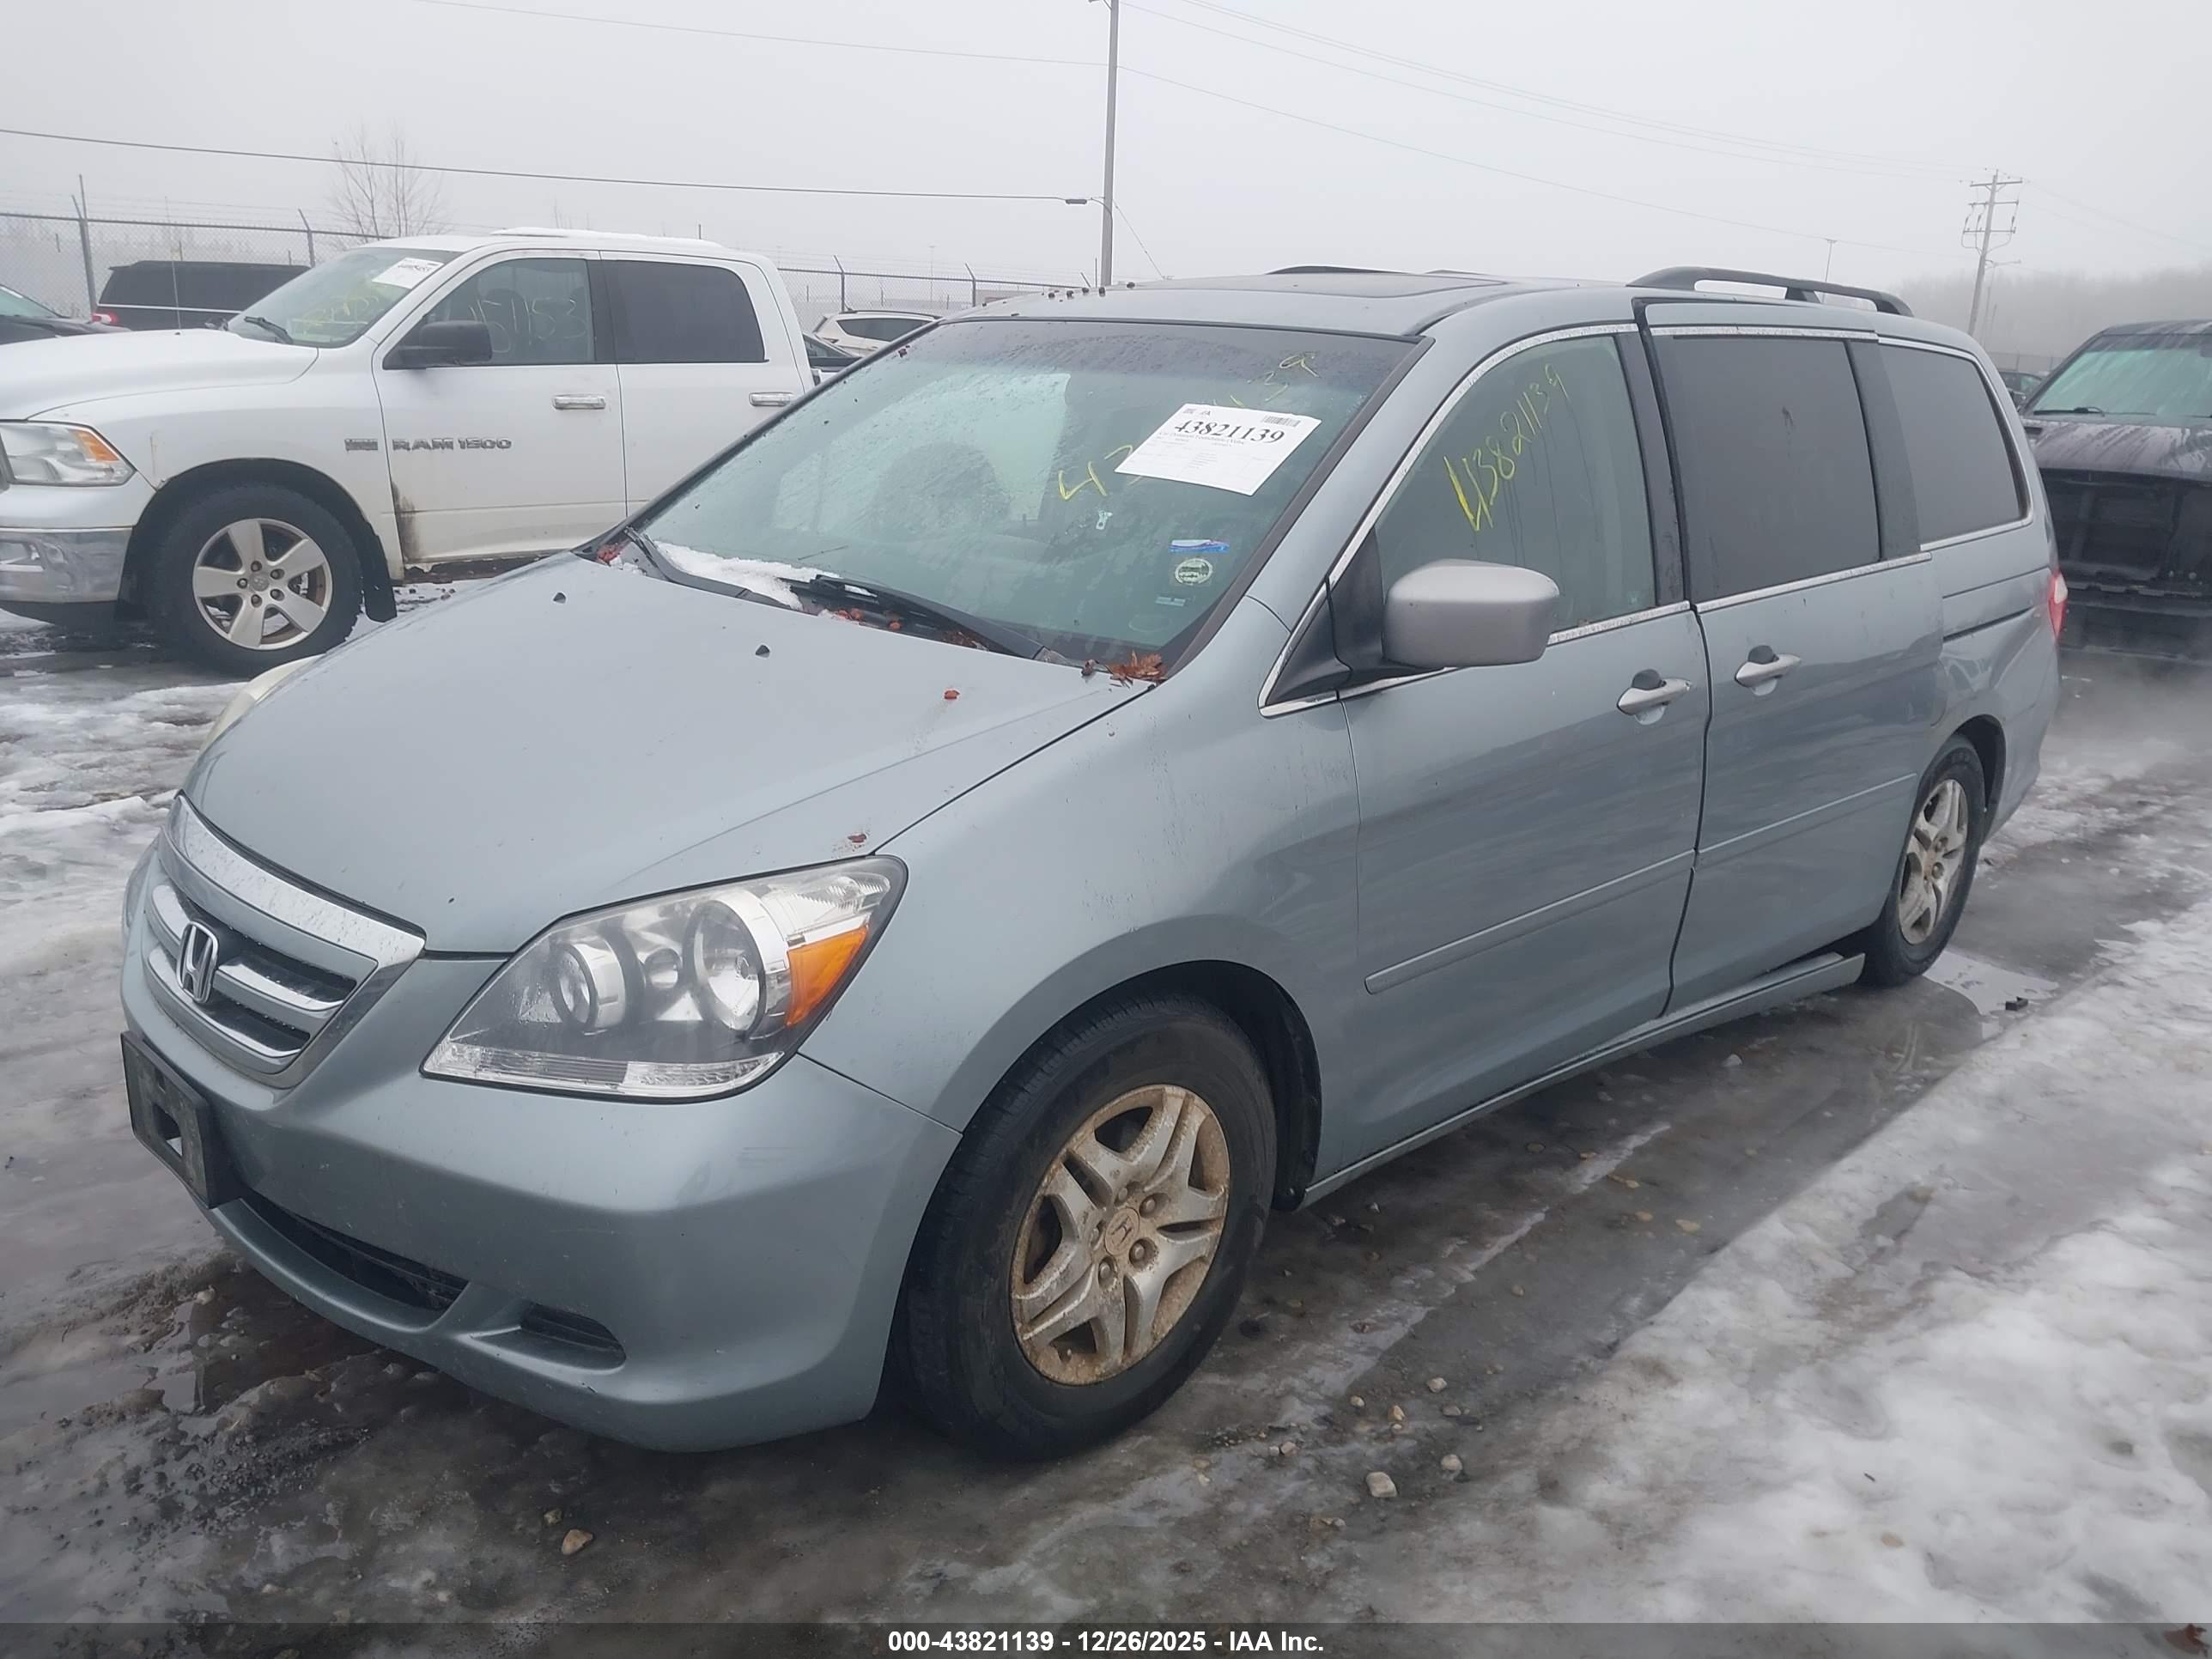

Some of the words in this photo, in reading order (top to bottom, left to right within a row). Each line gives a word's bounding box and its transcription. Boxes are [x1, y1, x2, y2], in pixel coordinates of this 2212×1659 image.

[1175, 419, 1285, 444] 43821139
[392, 438, 454, 452] RAM
[458, 437, 513, 450] 1500
